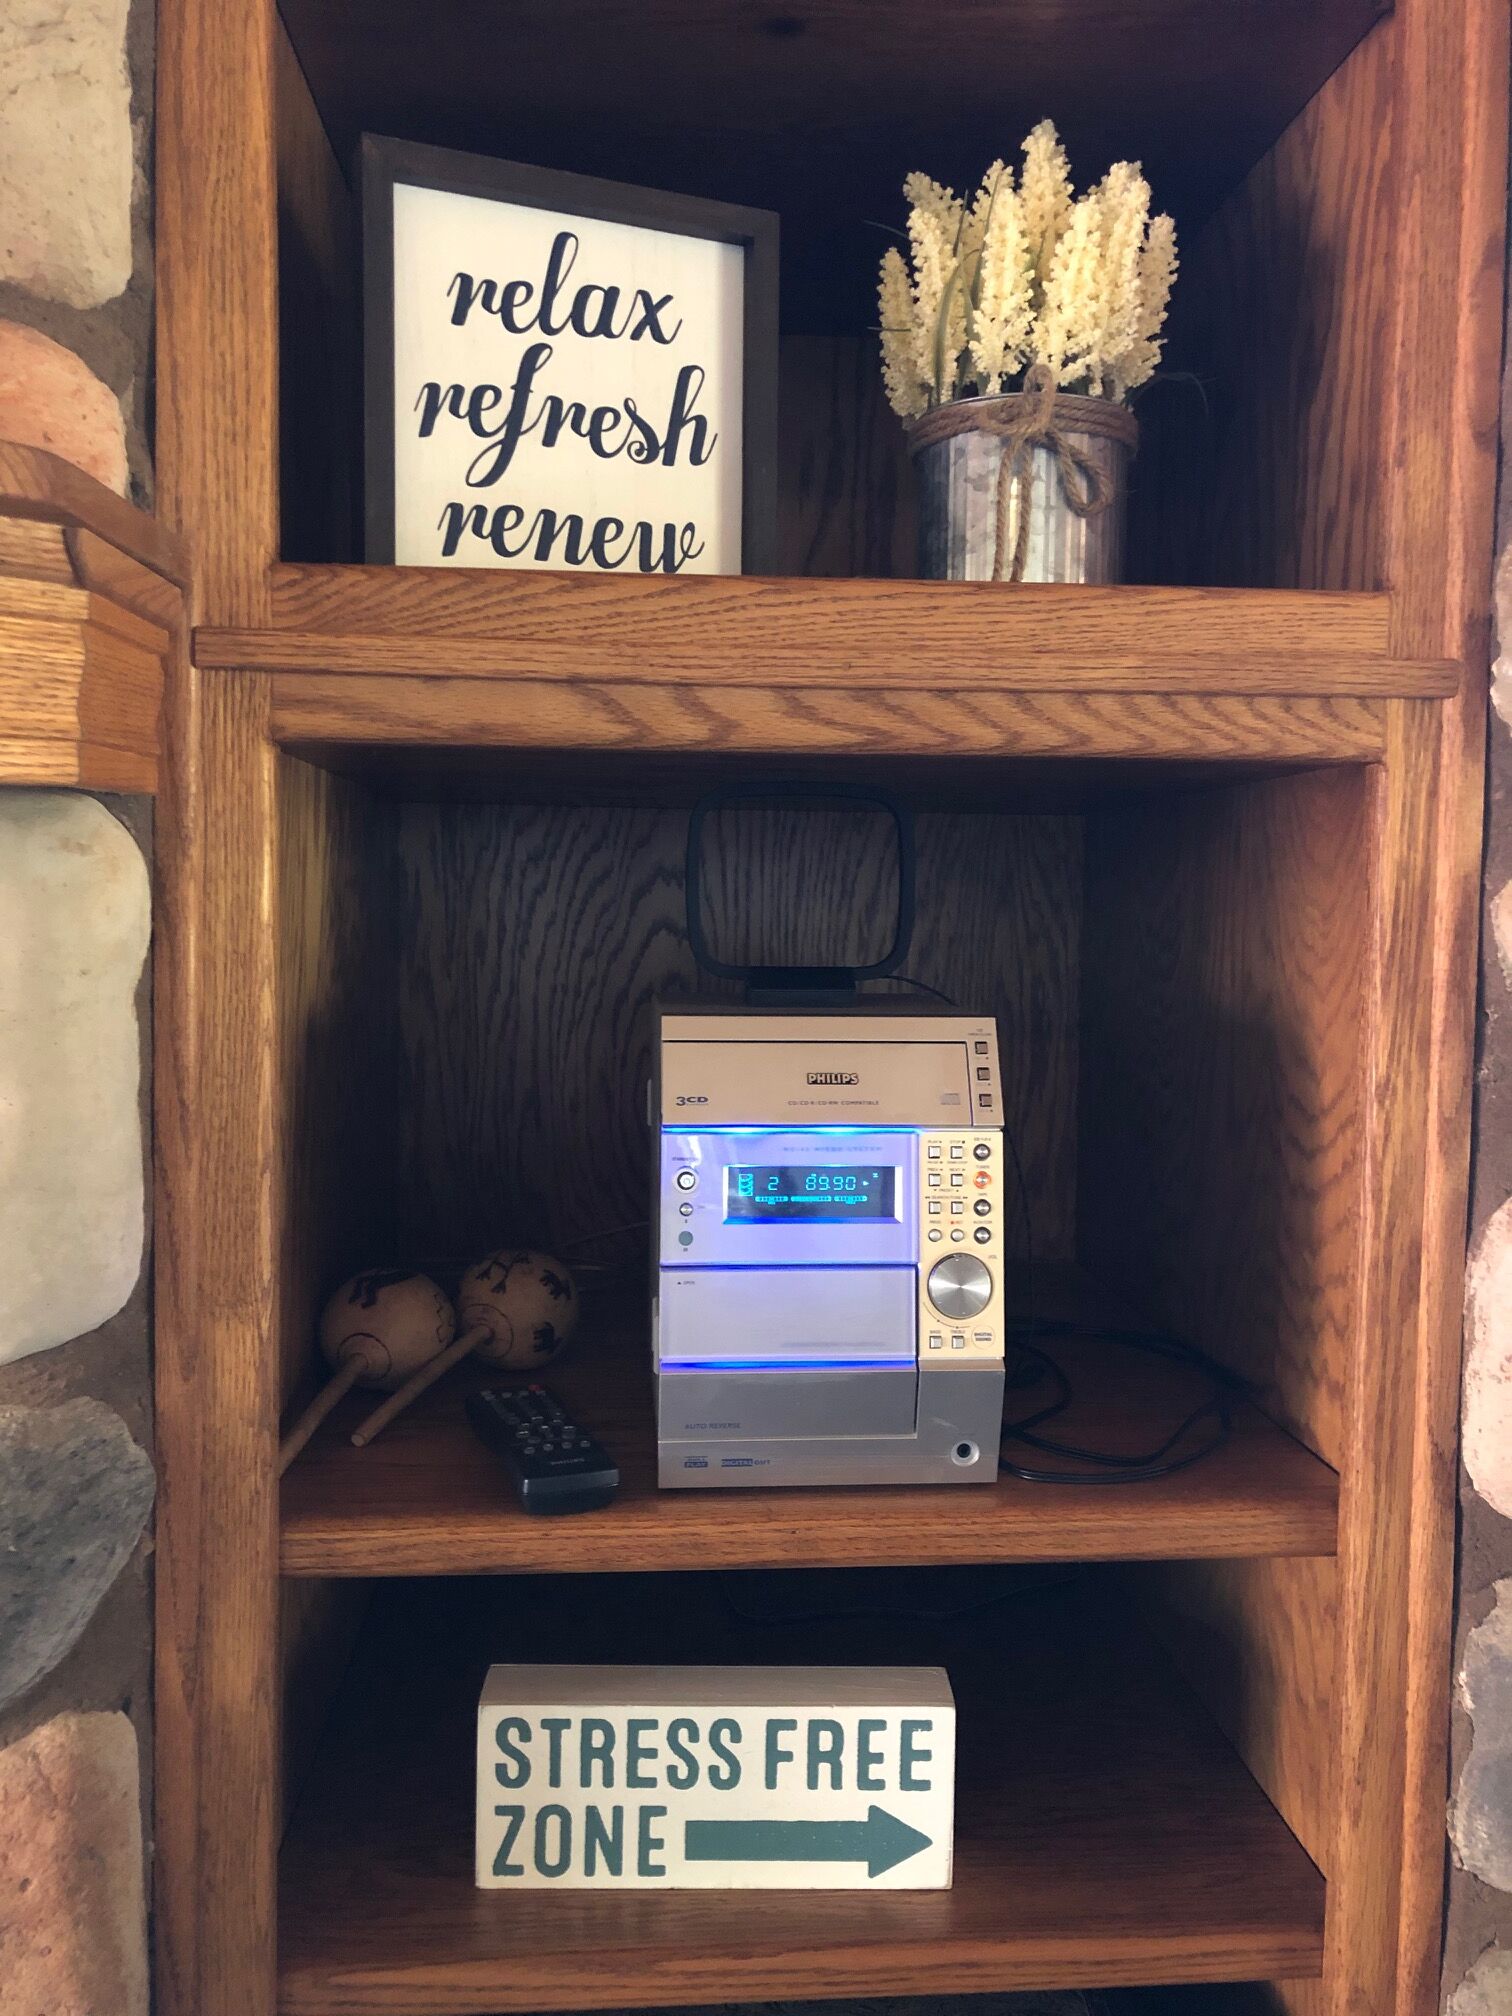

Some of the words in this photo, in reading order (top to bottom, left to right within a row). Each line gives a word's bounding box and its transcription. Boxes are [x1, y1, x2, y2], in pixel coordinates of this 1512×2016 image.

[447, 231, 683, 345] relax
[414, 342, 719, 488] refresh
[437, 501, 705, 574] renew
[676, 1096, 709, 1106] 3CD
[807, 1072, 859, 1085] PHILIPS
[768, 1176, 780, 1191] 2
[494, 1716, 743, 1791] STRESS
[764, 1718, 933, 1792] FREE
[491, 1803, 668, 1879] ZONE
